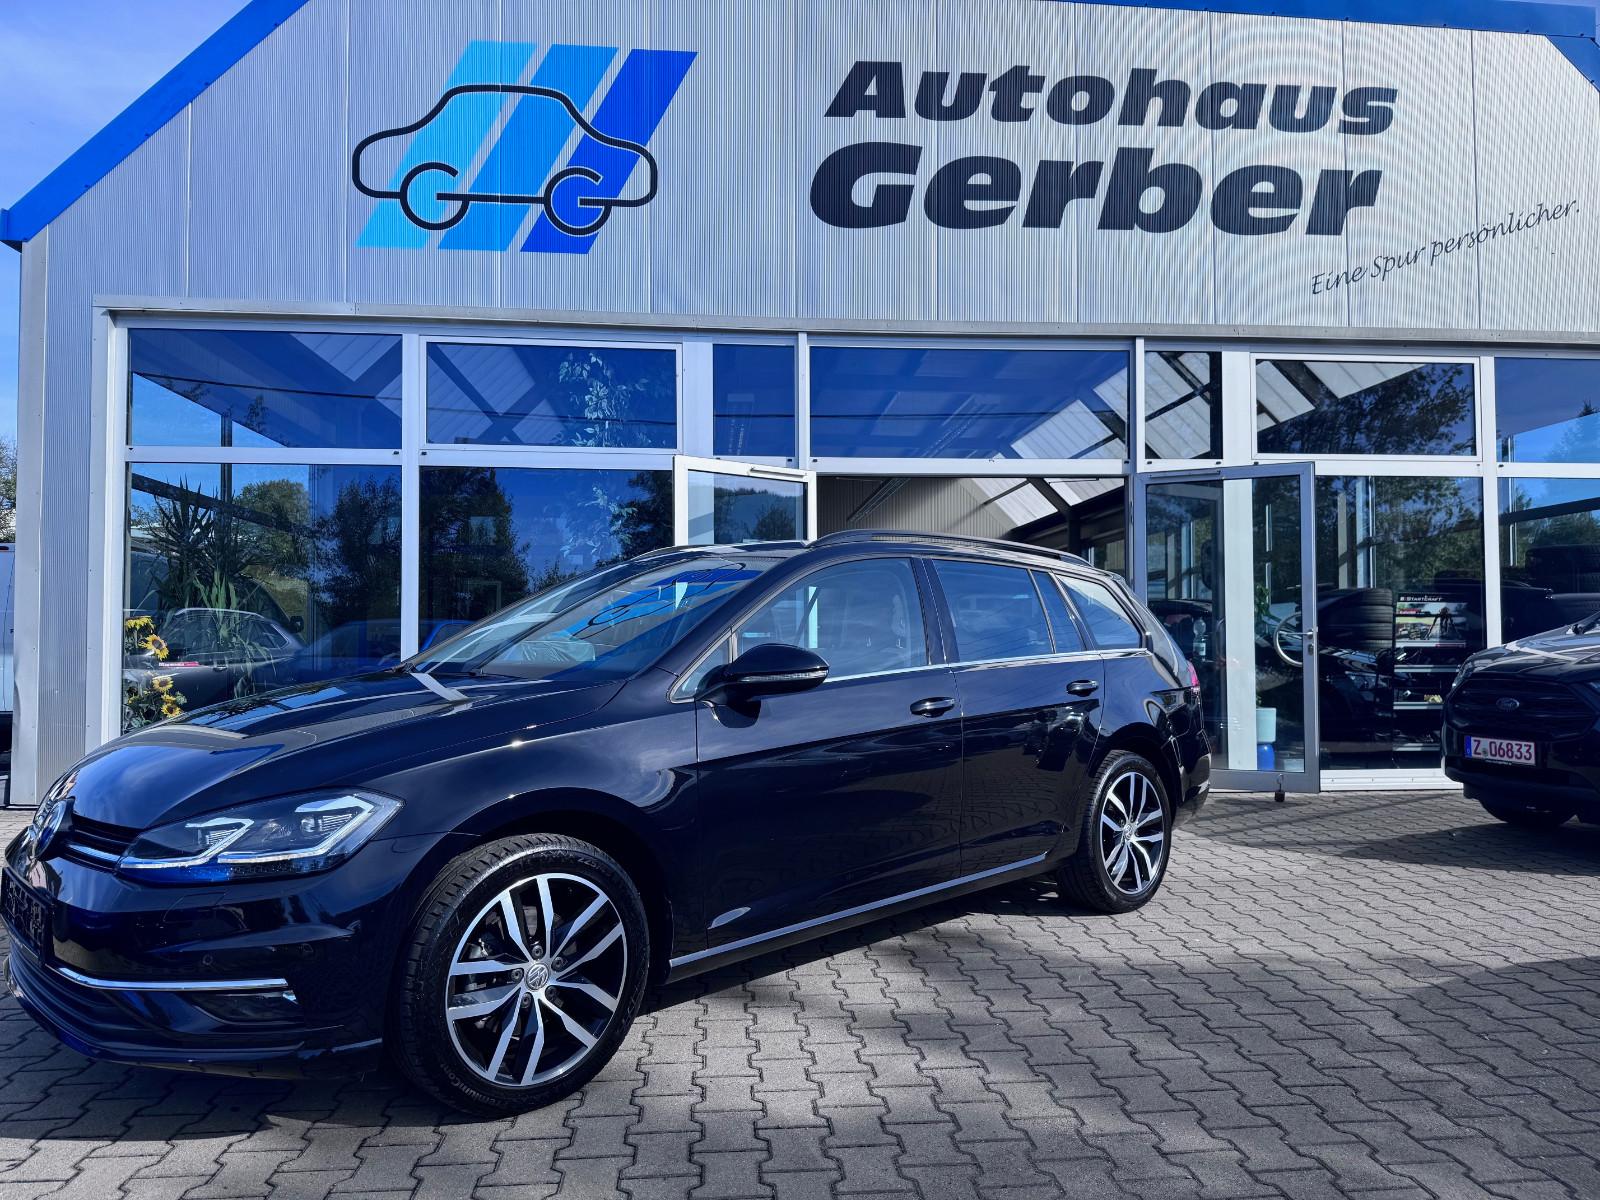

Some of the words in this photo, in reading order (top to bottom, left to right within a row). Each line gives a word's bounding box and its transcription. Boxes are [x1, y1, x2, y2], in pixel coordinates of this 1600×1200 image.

[825, 61, 1398, 135] Autohaus
[810, 142, 1381, 236] Gerber
[1311, 265, 1369, 295] Eine
[1370, 246, 1427, 281] Spur
[1430, 199, 1580, 266] persönlicher.
[1489, 740, 1532, 761] 06833
